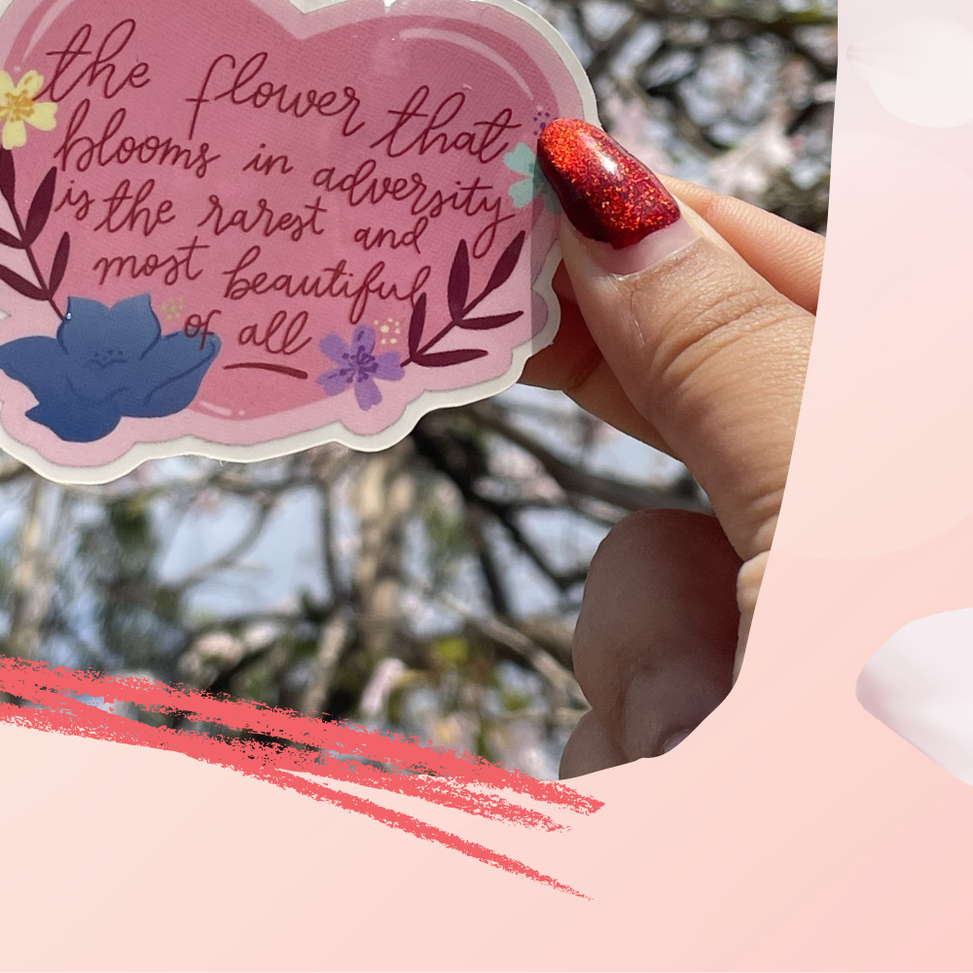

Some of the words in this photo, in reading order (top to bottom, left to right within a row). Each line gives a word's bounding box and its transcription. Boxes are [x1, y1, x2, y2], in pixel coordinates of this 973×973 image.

[33, 19, 151, 102] the
[185, 52, 366, 140] flower
[371, 86, 522, 164] that
[54, 99, 221, 179] blooms
[243, 142, 293, 176] in
[312, 159, 517, 259] adversity
[55, 179, 95, 220] is
[93, 179, 176, 235] the
[196, 194, 328, 242] rarest
[354, 217, 429, 254] and
[93, 235, 210, 286] most
[224, 245, 432, 325] beautiful
[183, 309, 221, 350] of
[239, 310, 312, 356] all
